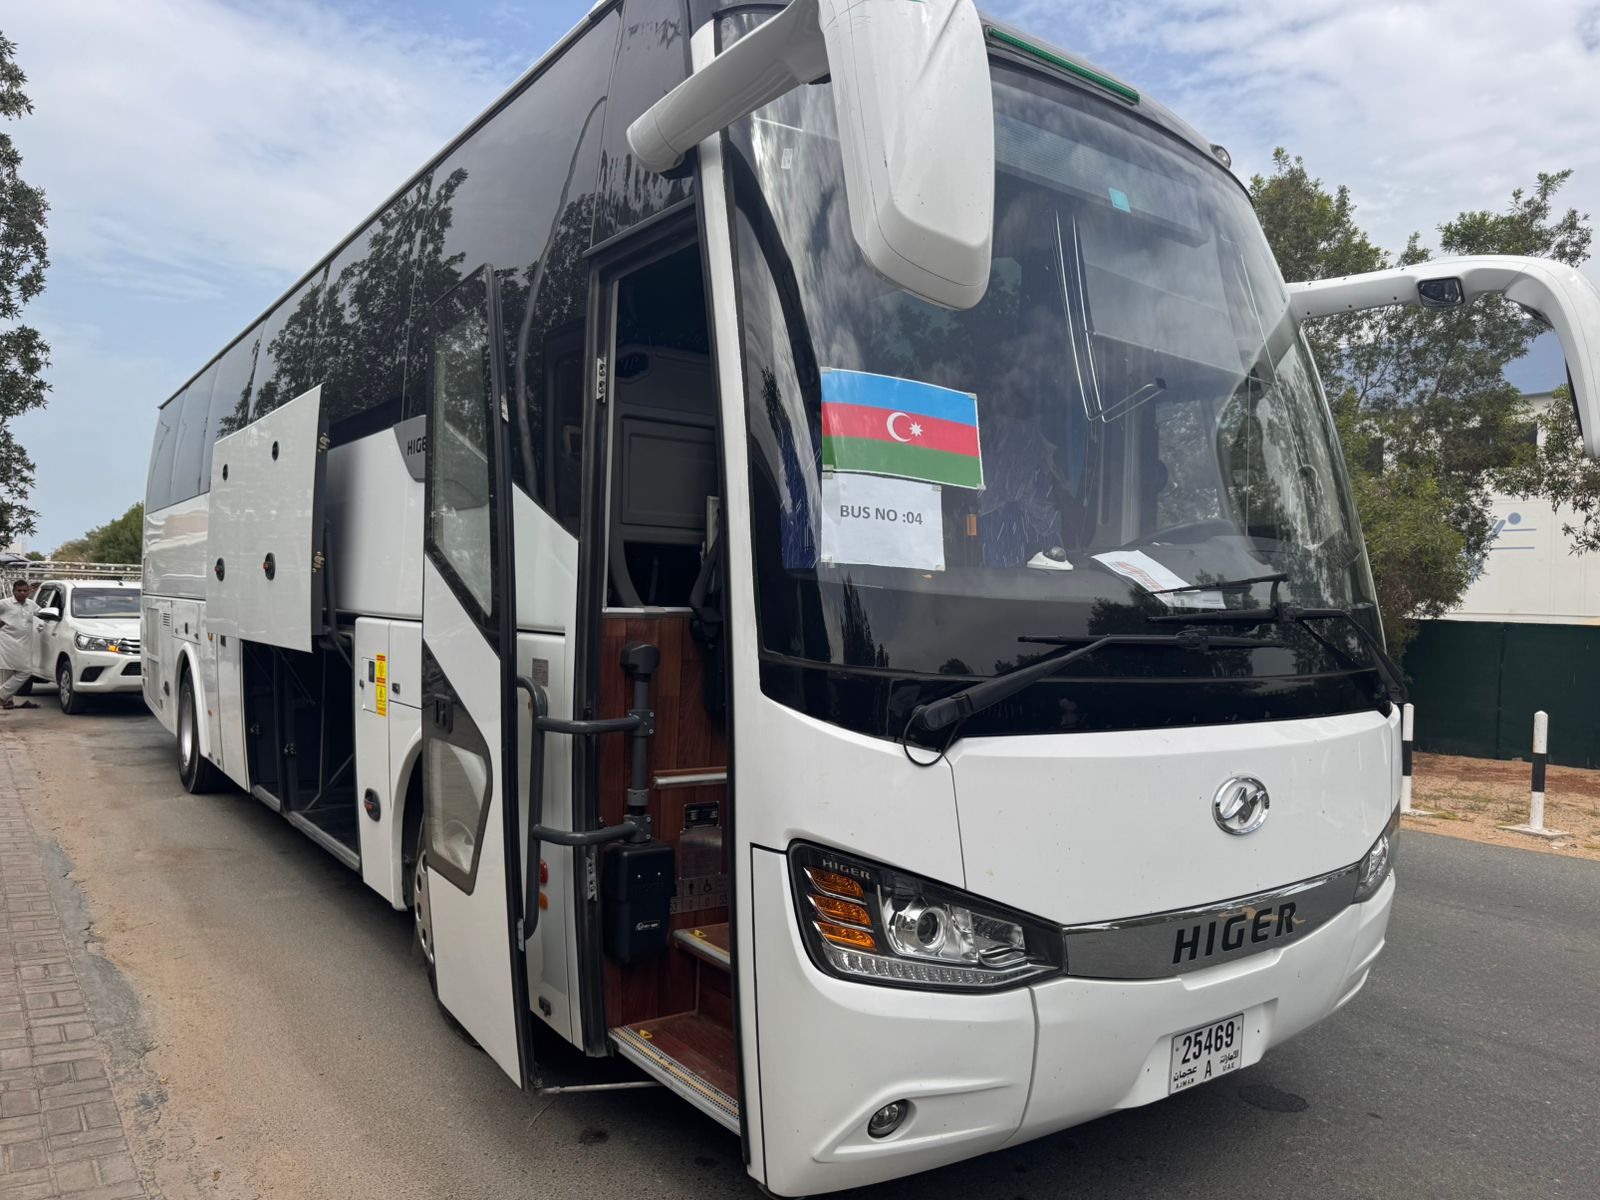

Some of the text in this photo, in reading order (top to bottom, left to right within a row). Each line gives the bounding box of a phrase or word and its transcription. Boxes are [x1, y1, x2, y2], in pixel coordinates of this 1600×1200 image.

[407, 436, 426, 456] HIGE
[840, 504, 923, 525] BUS NO :04
[822, 858, 871, 880] HIGER
[1172, 901, 1297, 965] HIGER
[1181, 1020, 1235, 1065] 25469
[1173, 1065, 1198, 1082] عجمان
[1204, 1059, 1212, 1079] A
[1222, 1061, 1235, 1073] UAE
